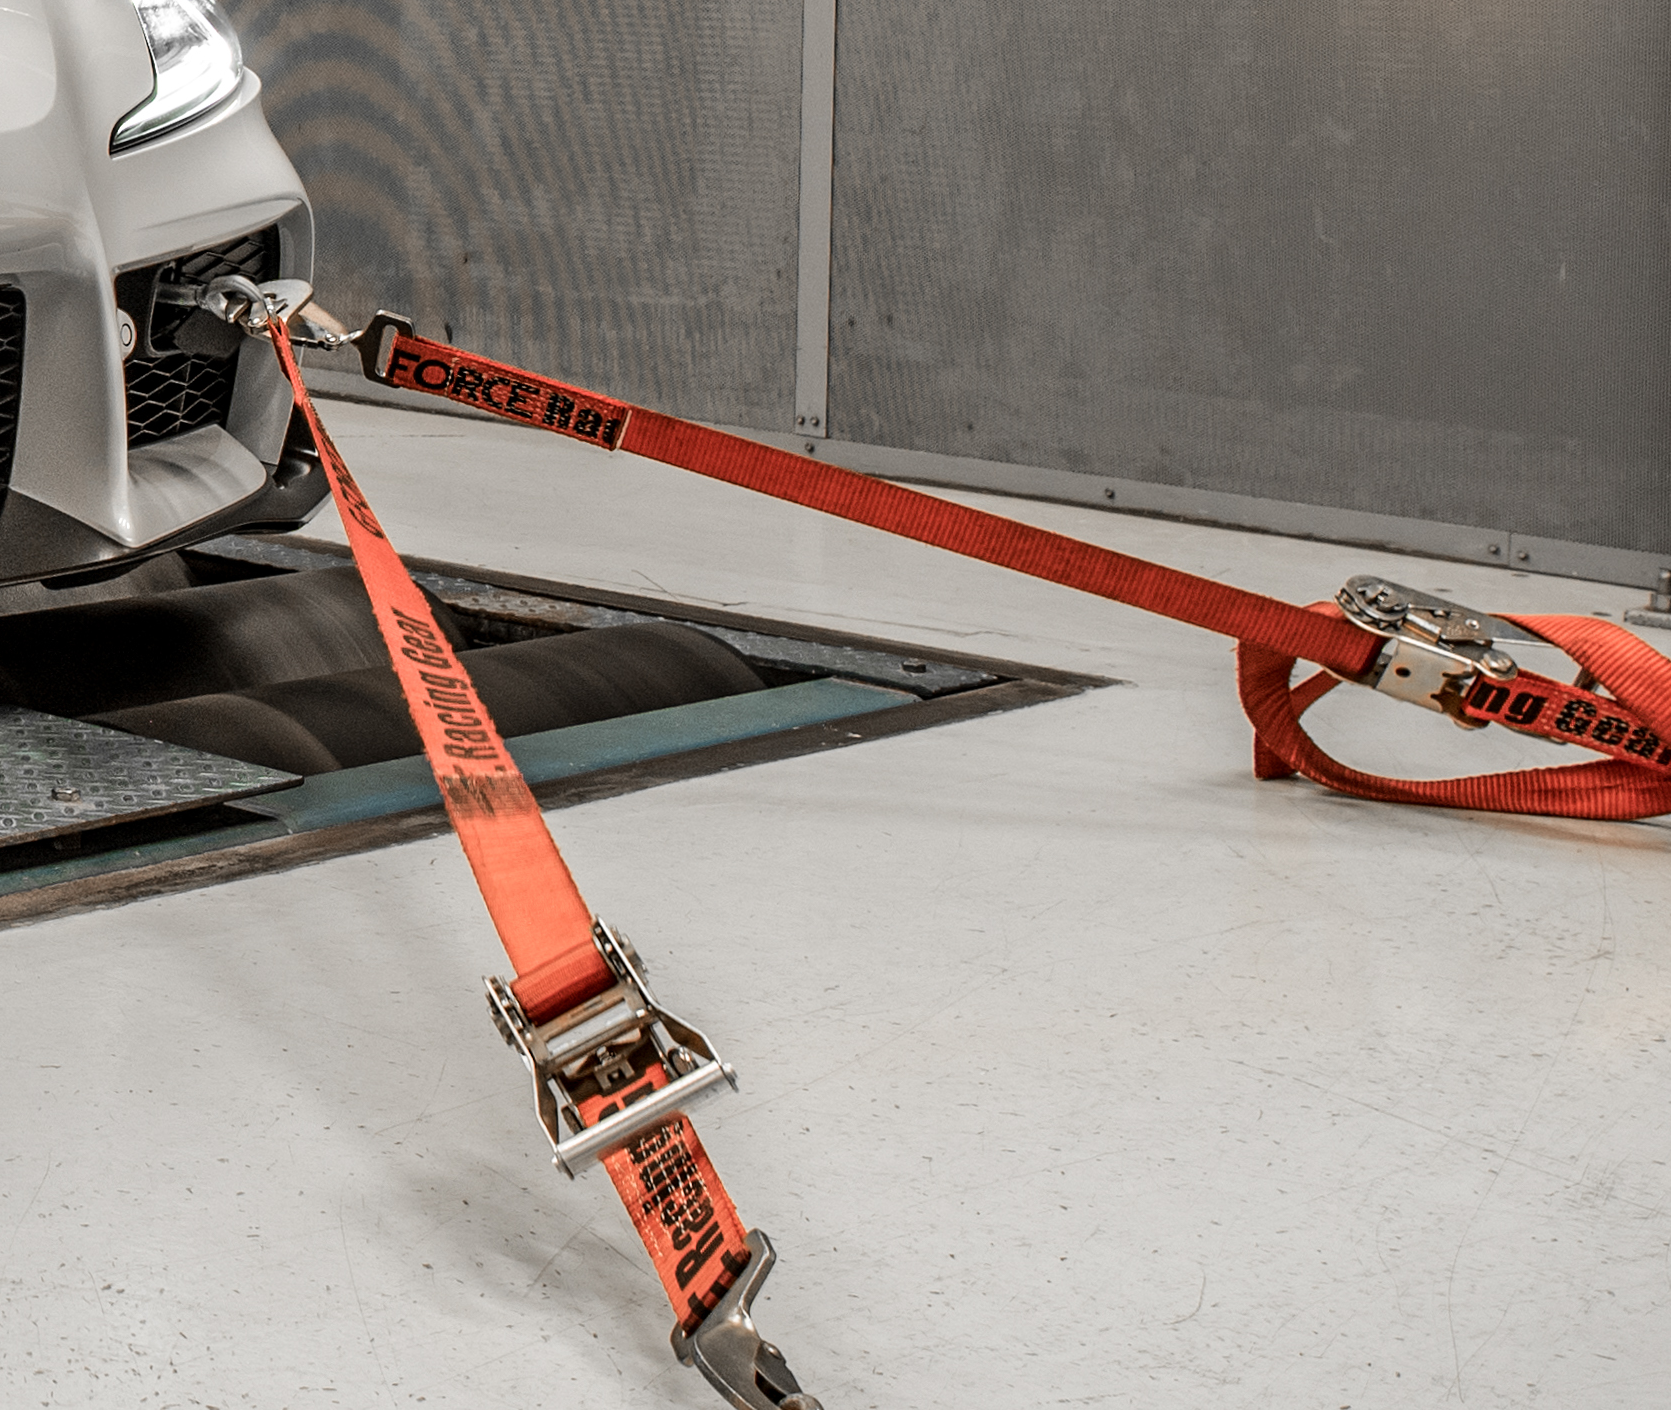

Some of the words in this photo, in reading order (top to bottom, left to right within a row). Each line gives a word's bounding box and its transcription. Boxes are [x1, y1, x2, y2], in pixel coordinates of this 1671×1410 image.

[388, 347, 541, 419] FORCE
[391, 607, 452, 669] Gear
[419, 670, 499, 760] Racing
[1469, 681, 1549, 725] ng
